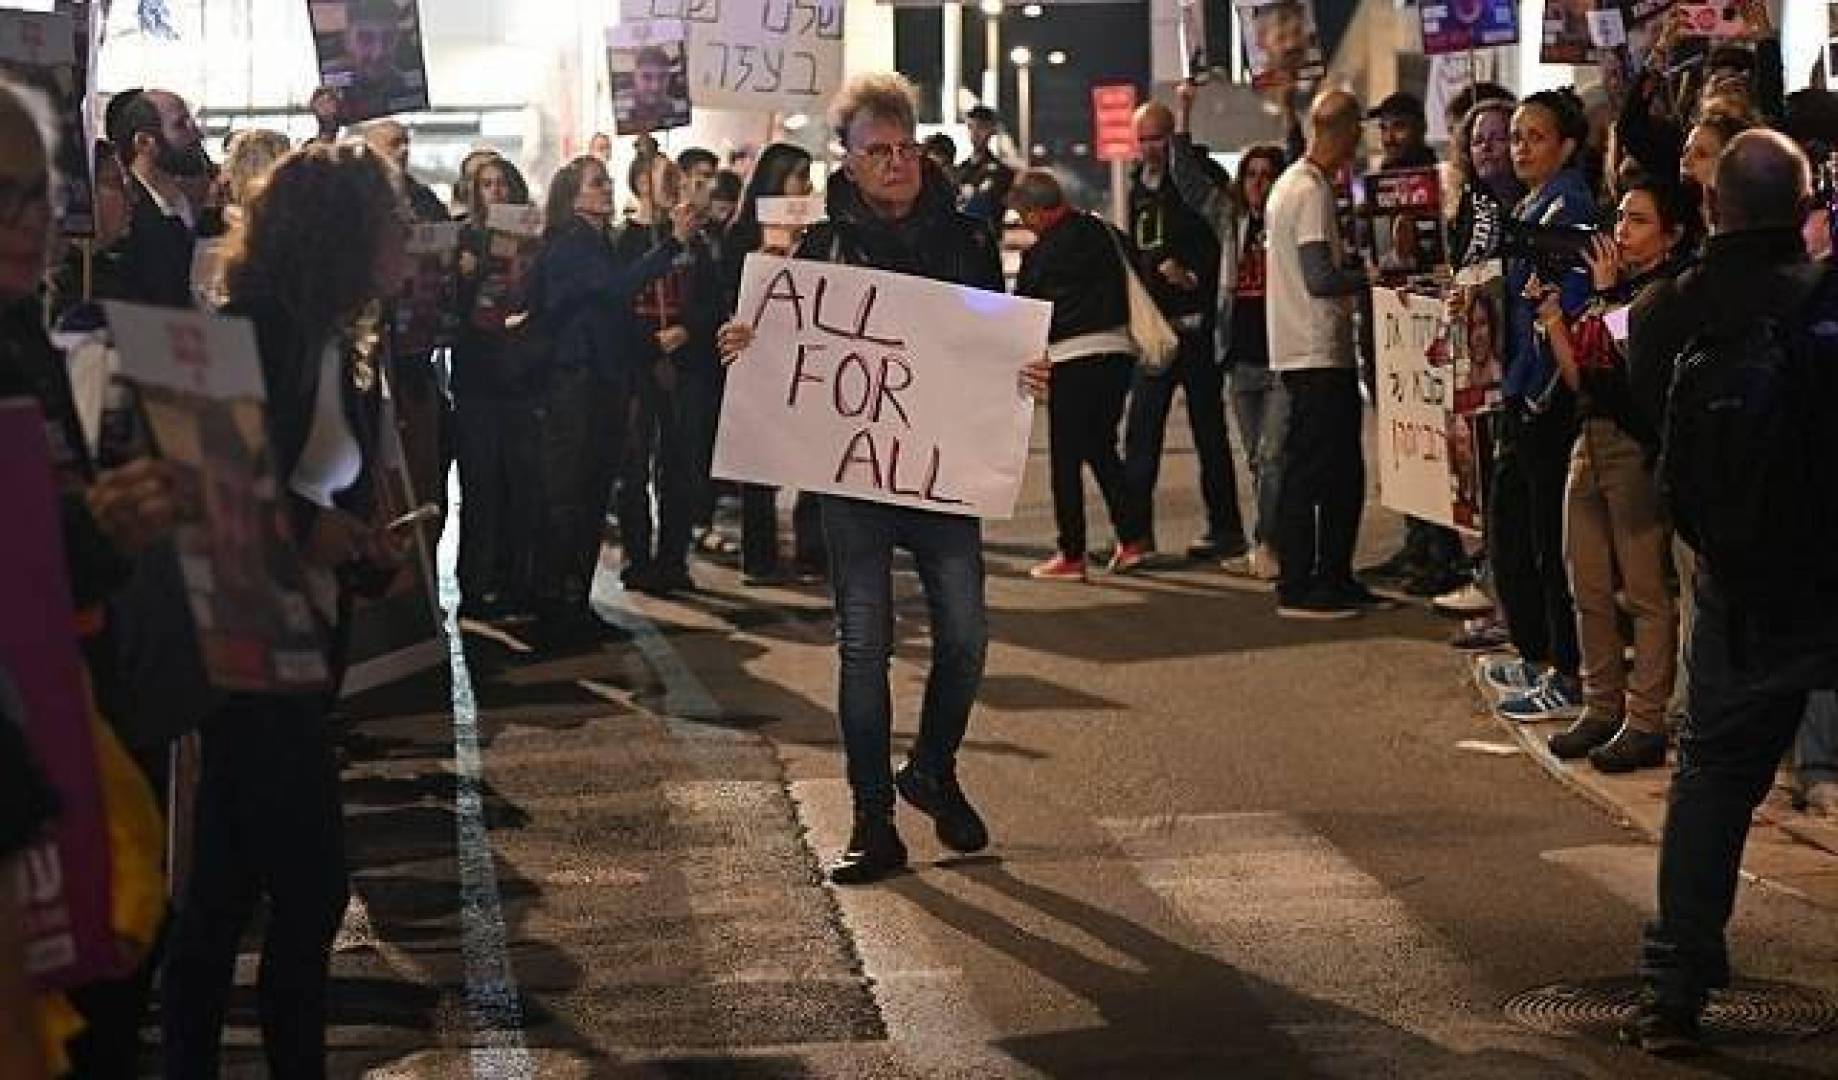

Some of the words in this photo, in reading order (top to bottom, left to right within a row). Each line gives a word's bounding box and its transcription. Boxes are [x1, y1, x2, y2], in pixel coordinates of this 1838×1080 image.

[752, 267, 904, 347] ALL
[787, 344, 911, 429] FOR
[835, 428, 973, 506] ALL
